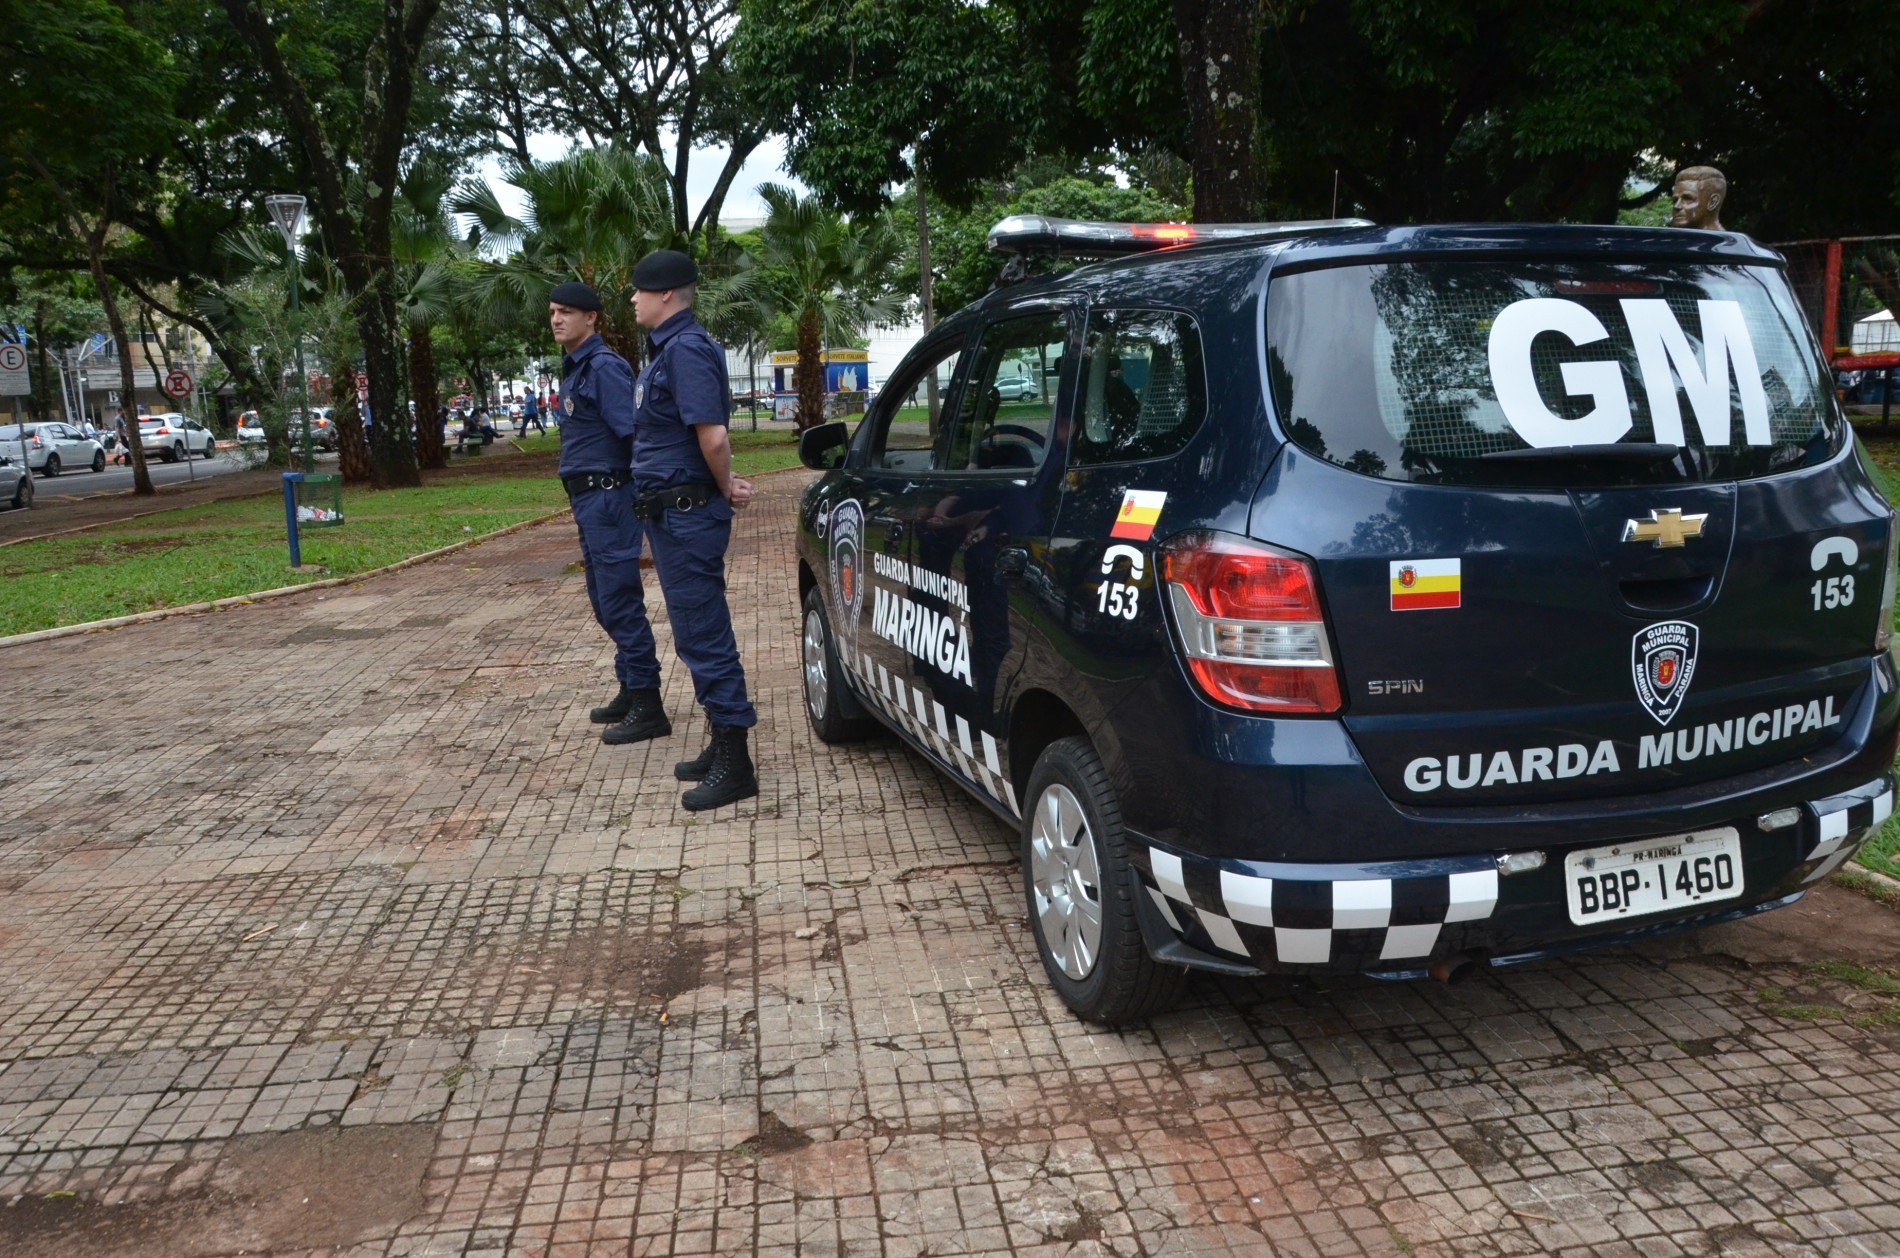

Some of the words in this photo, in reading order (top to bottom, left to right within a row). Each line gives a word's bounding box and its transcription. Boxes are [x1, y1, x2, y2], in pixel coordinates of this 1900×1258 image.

[7, 351, 16, 365] E
[1488, 298, 1772, 448] GM
[838, 506, 858, 528] GUARDA
[834, 523, 859, 549] MUNICIPAL
[874, 552, 911, 586] GUARDA
[912, 565, 971, 613] MUNICIPAL
[1097, 580, 1139, 620] 153
[1811, 574, 1855, 611] 153
[872, 585, 973, 687] MARINGÁ
[1641, 634, 1690, 653] MUNICIPAL
[1647, 625, 1687, 640] GUARDA
[1368, 679, 1424, 695] SPIN
[1636, 663, 1656, 707] MARINGÁ
[1404, 740, 1621, 792] GUARDA
[1638, 695, 1840, 769] MUNICIPAL
